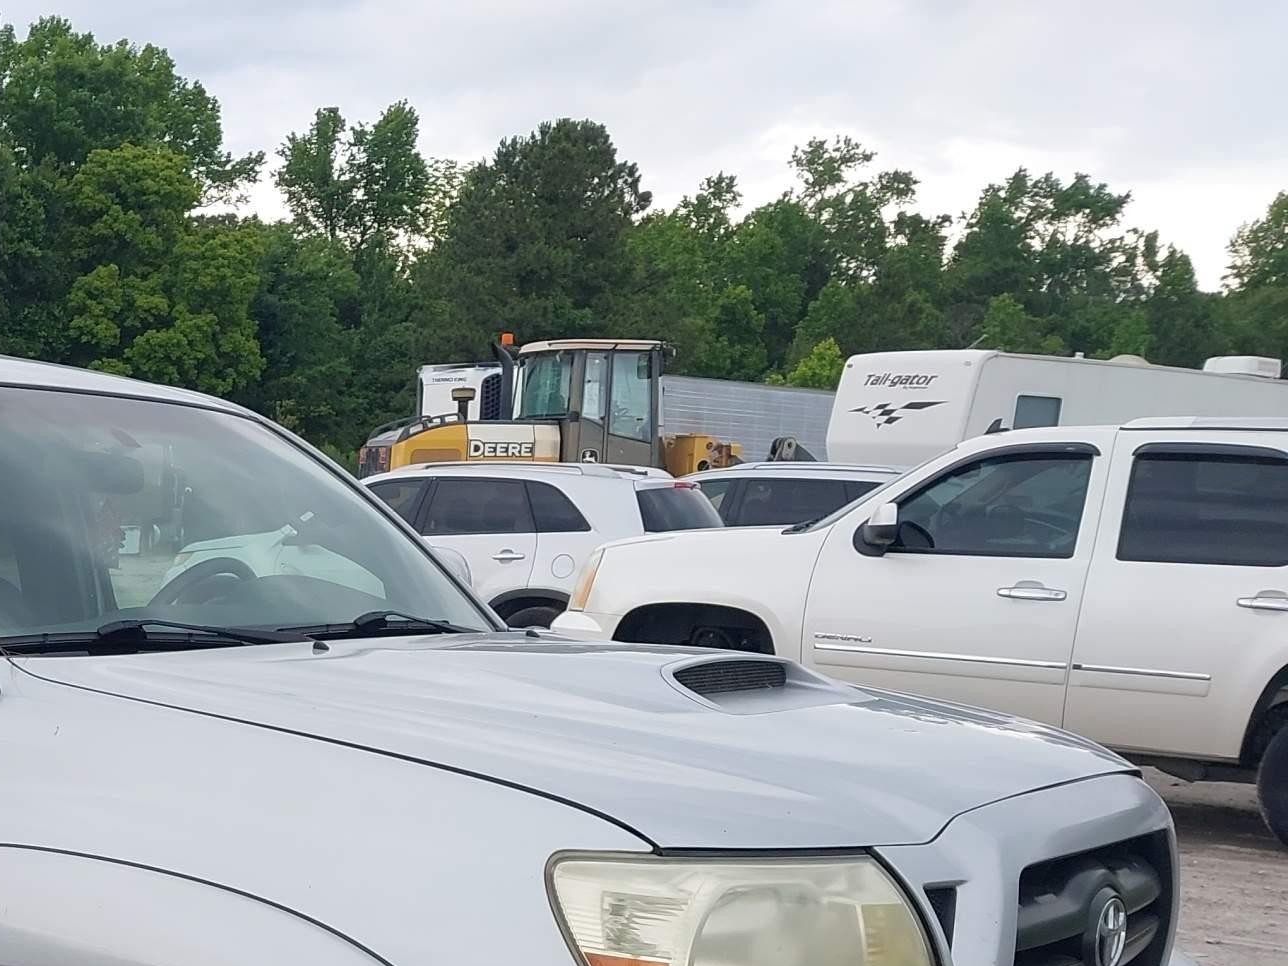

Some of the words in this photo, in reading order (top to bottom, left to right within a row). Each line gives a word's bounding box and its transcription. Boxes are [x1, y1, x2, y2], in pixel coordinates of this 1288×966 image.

[864, 373, 938, 388] Tail-gator
[469, 439, 535, 458] DEERE
[814, 632, 872, 643] DENALI
